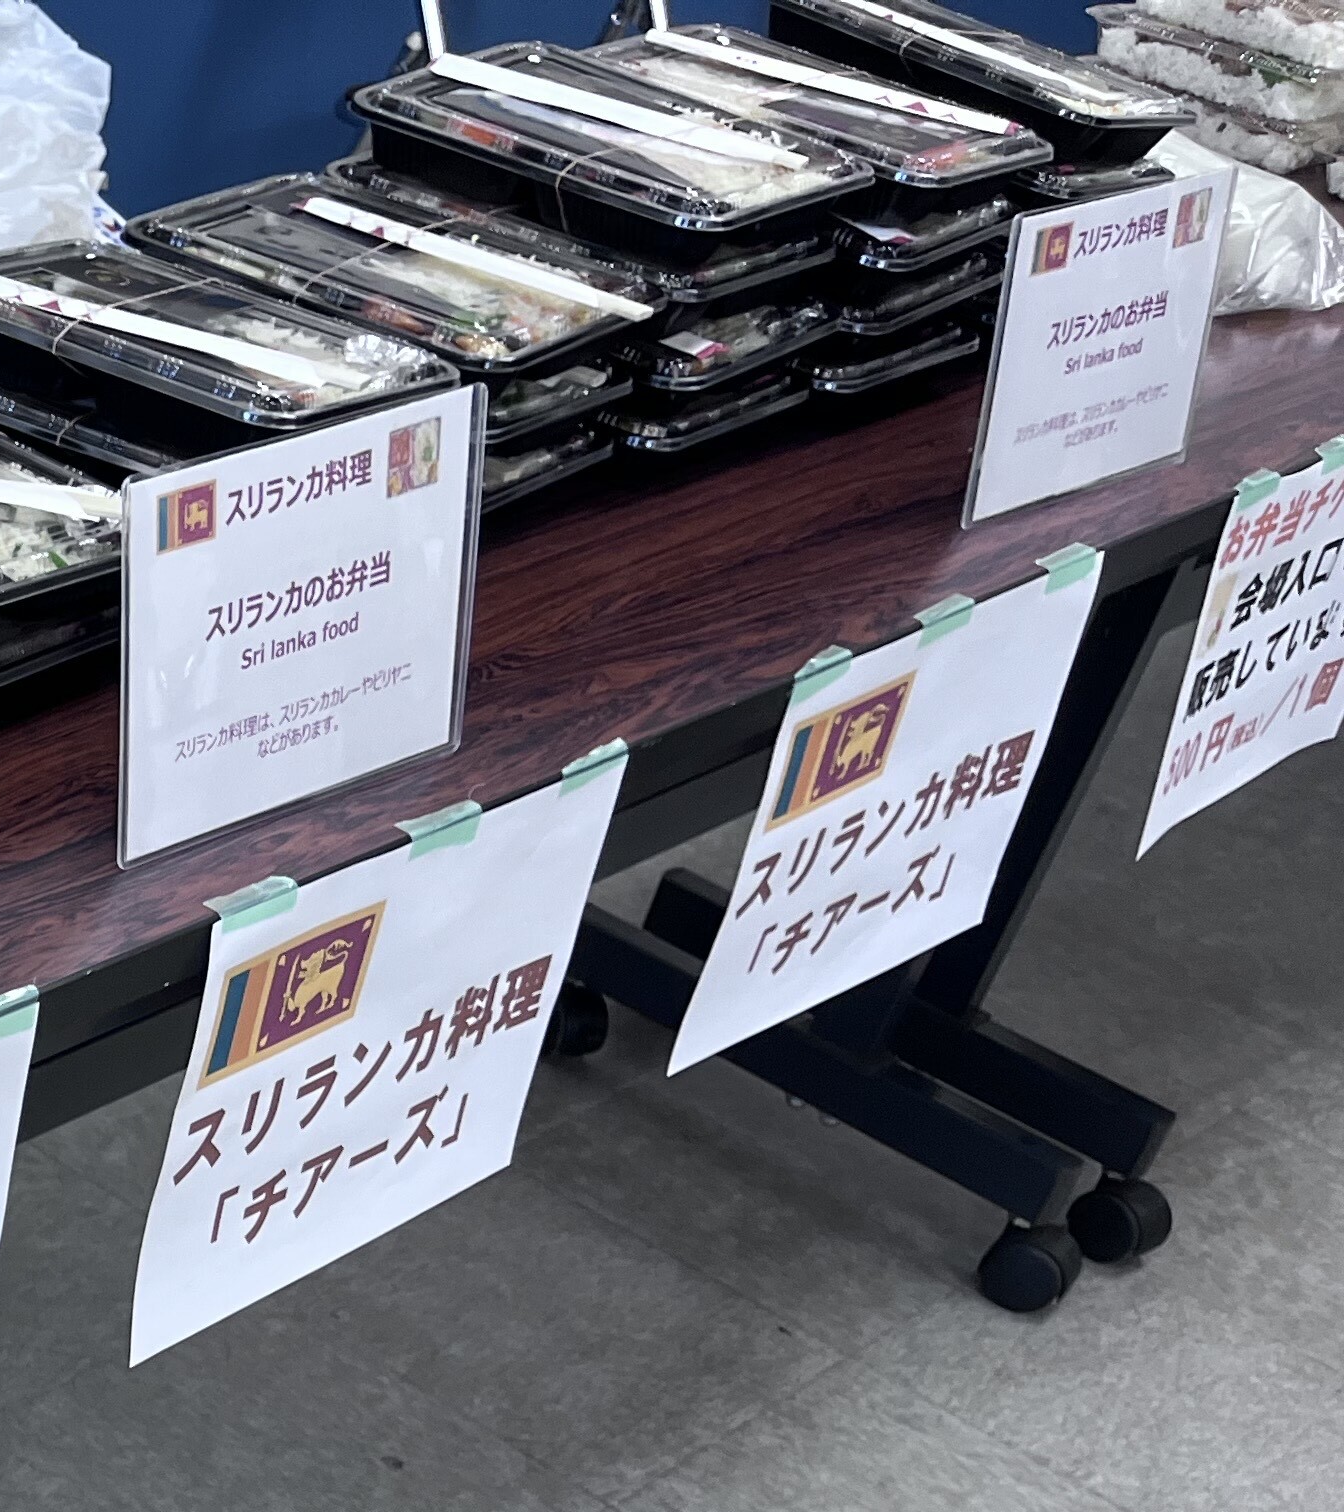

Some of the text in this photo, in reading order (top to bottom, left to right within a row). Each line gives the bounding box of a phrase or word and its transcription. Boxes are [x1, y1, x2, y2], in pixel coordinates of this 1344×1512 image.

[1074, 208, 1168, 260] スリランカ料理
[1047, 291, 1168, 350] スリランカのお弁当
[226, 449, 372, 526] スリランカ料理
[205, 551, 391, 642] スリランカのお弁当
[1229, 538, 1344, 632] 会場入口
[241, 612, 359, 670] Sri lanka food
[735, 731, 1035, 919] スリランカ料理
[748, 845, 955, 973] 「チアーズ」
[173, 954, 553, 1186] スリランカ料理
[210, 1084, 468, 1243] 「チアーズ」
